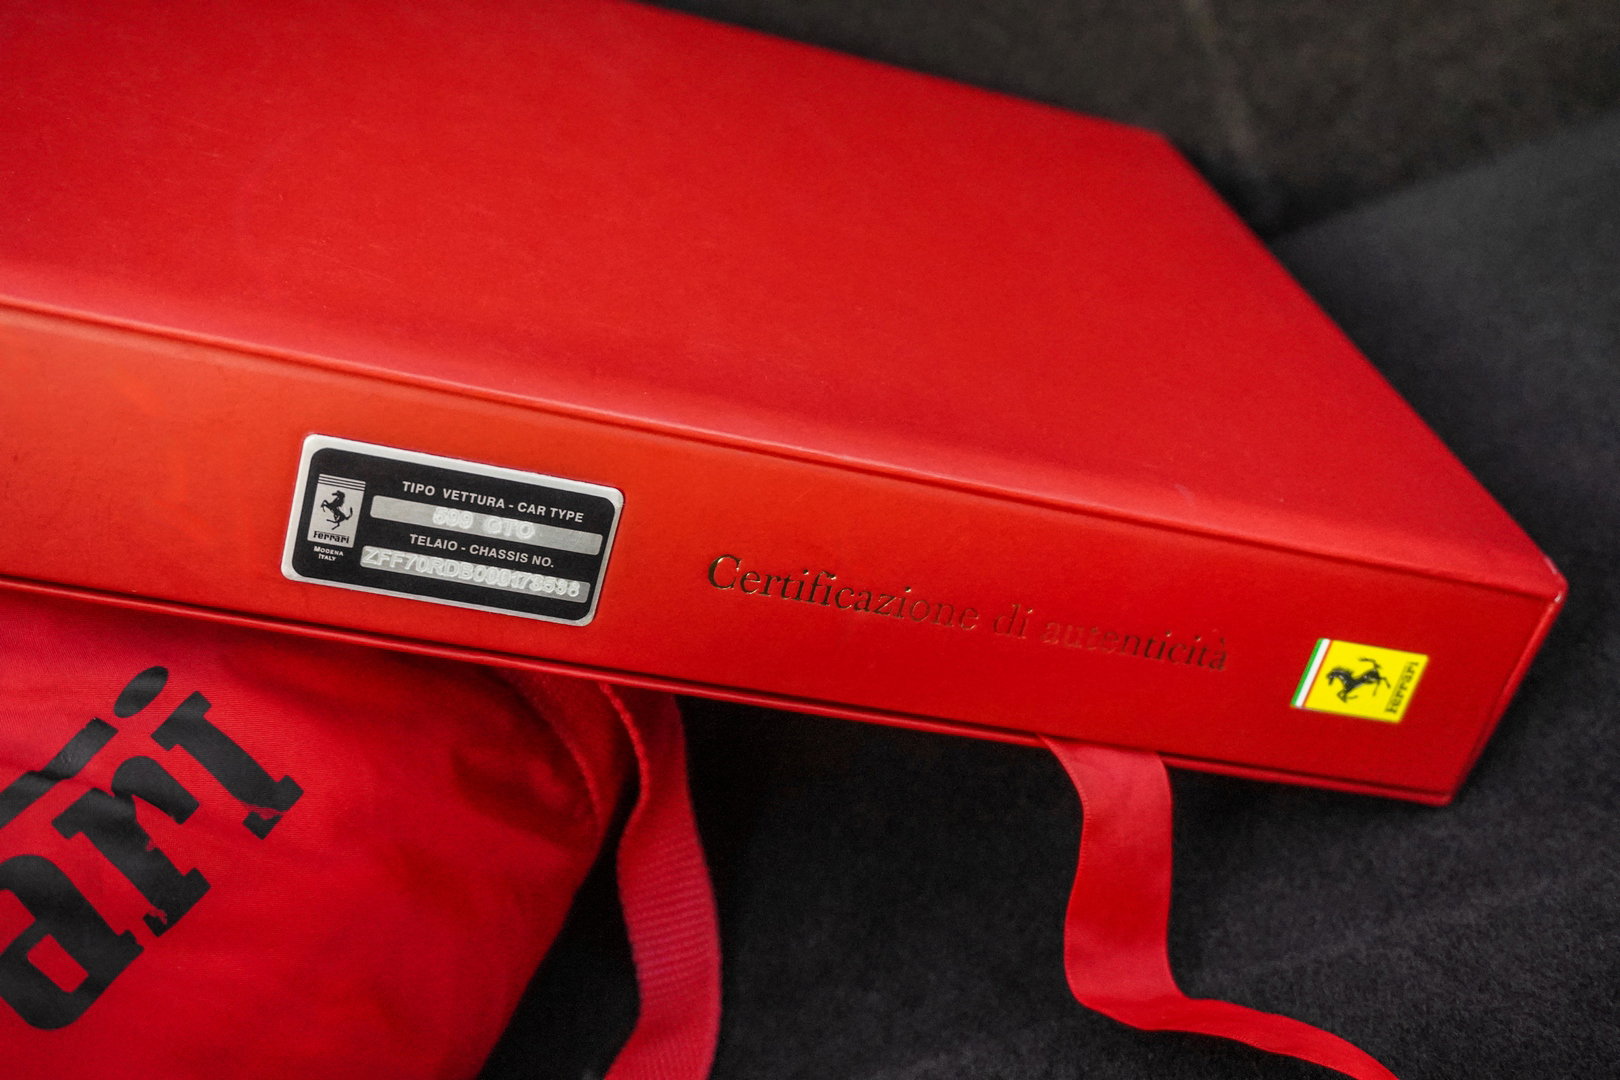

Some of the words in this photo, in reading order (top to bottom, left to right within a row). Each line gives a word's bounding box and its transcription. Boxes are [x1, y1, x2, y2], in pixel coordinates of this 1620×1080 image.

[402, 480, 436, 497] TIPO
[442, 488, 506, 510] VETTURA
[517, 501, 547, 517] CAR
[550, 506, 584, 523] TYPE
[313, 530, 350, 544] Ferrari
[483, 515, 536, 540] GTO
[313, 545, 344, 556] MODENA
[318, 553, 336, 561] ITALY
[409, 533, 458, 551] TELAIO
[469, 544, 529, 564] CHASSIS
[531, 554, 554, 568] NO.
[707, 553, 980, 631] Certificazione
[992, 603, 1033, 640] di
[1041, 622, 1228, 671] autenticità
[1384, 661, 1419, 714] Ferrari
